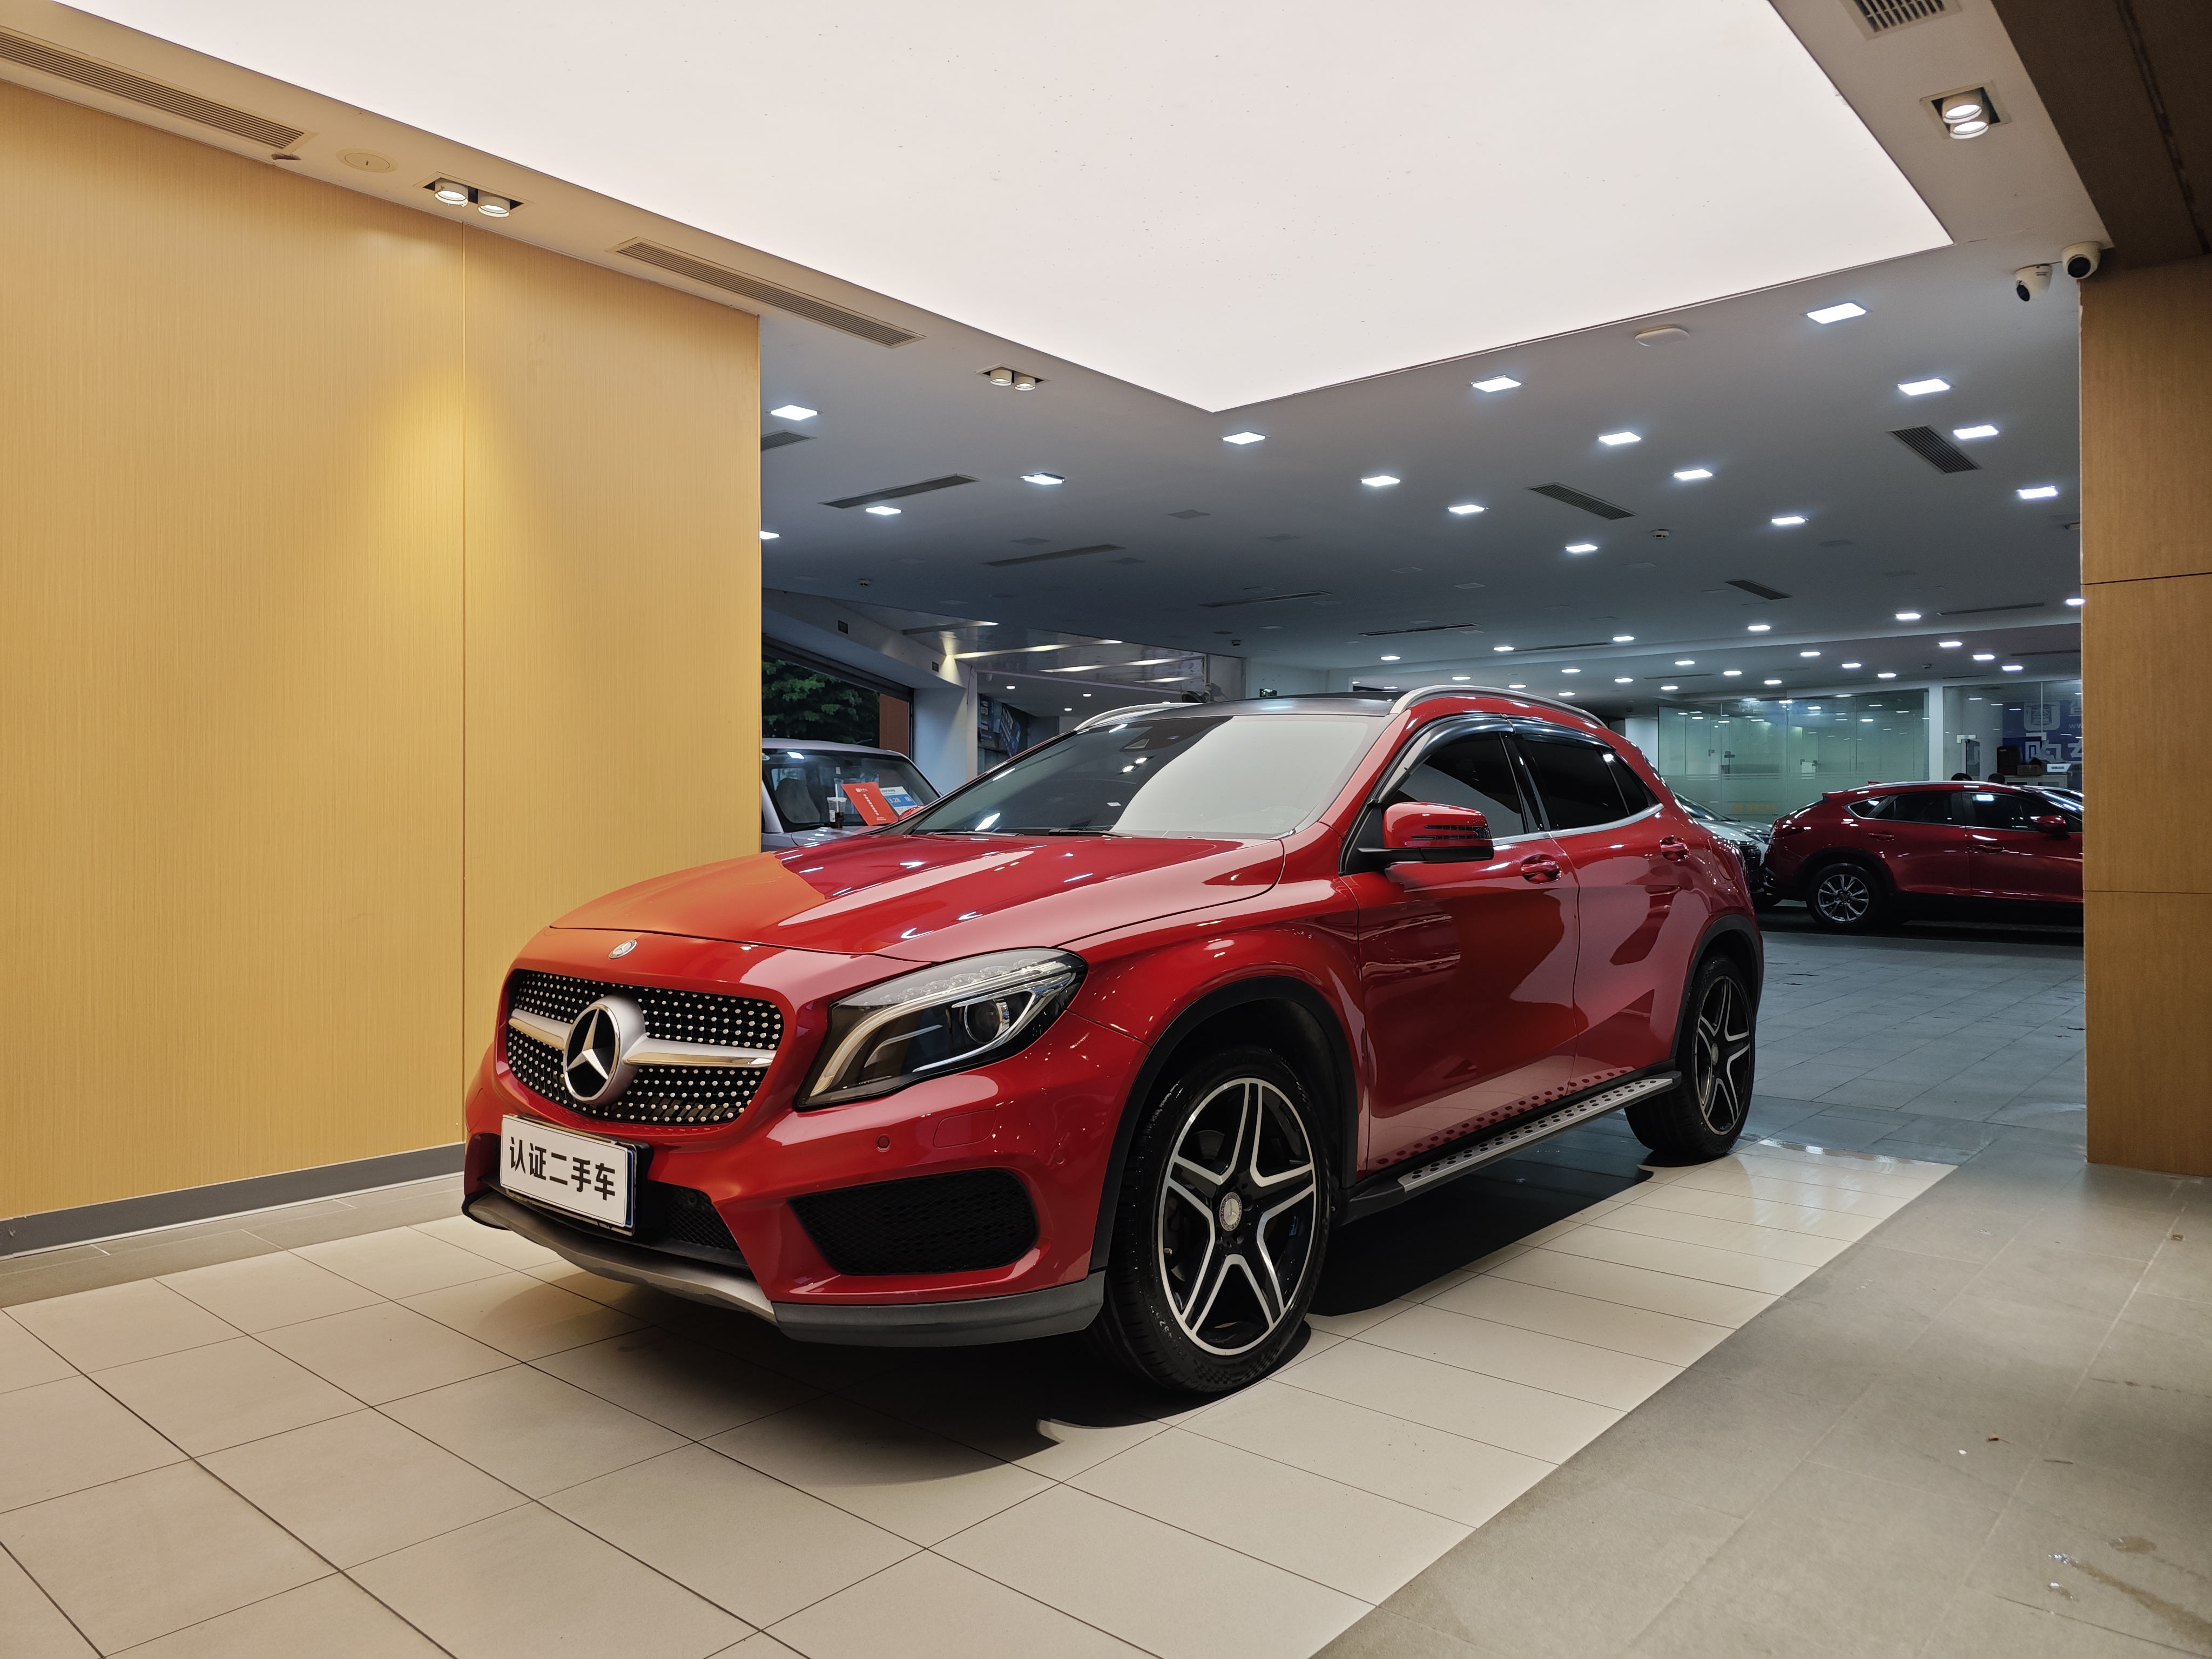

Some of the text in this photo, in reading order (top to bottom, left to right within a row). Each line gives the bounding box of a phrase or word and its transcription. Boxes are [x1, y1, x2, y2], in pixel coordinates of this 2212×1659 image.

[510, 1136, 615, 1201] 认证二手车
